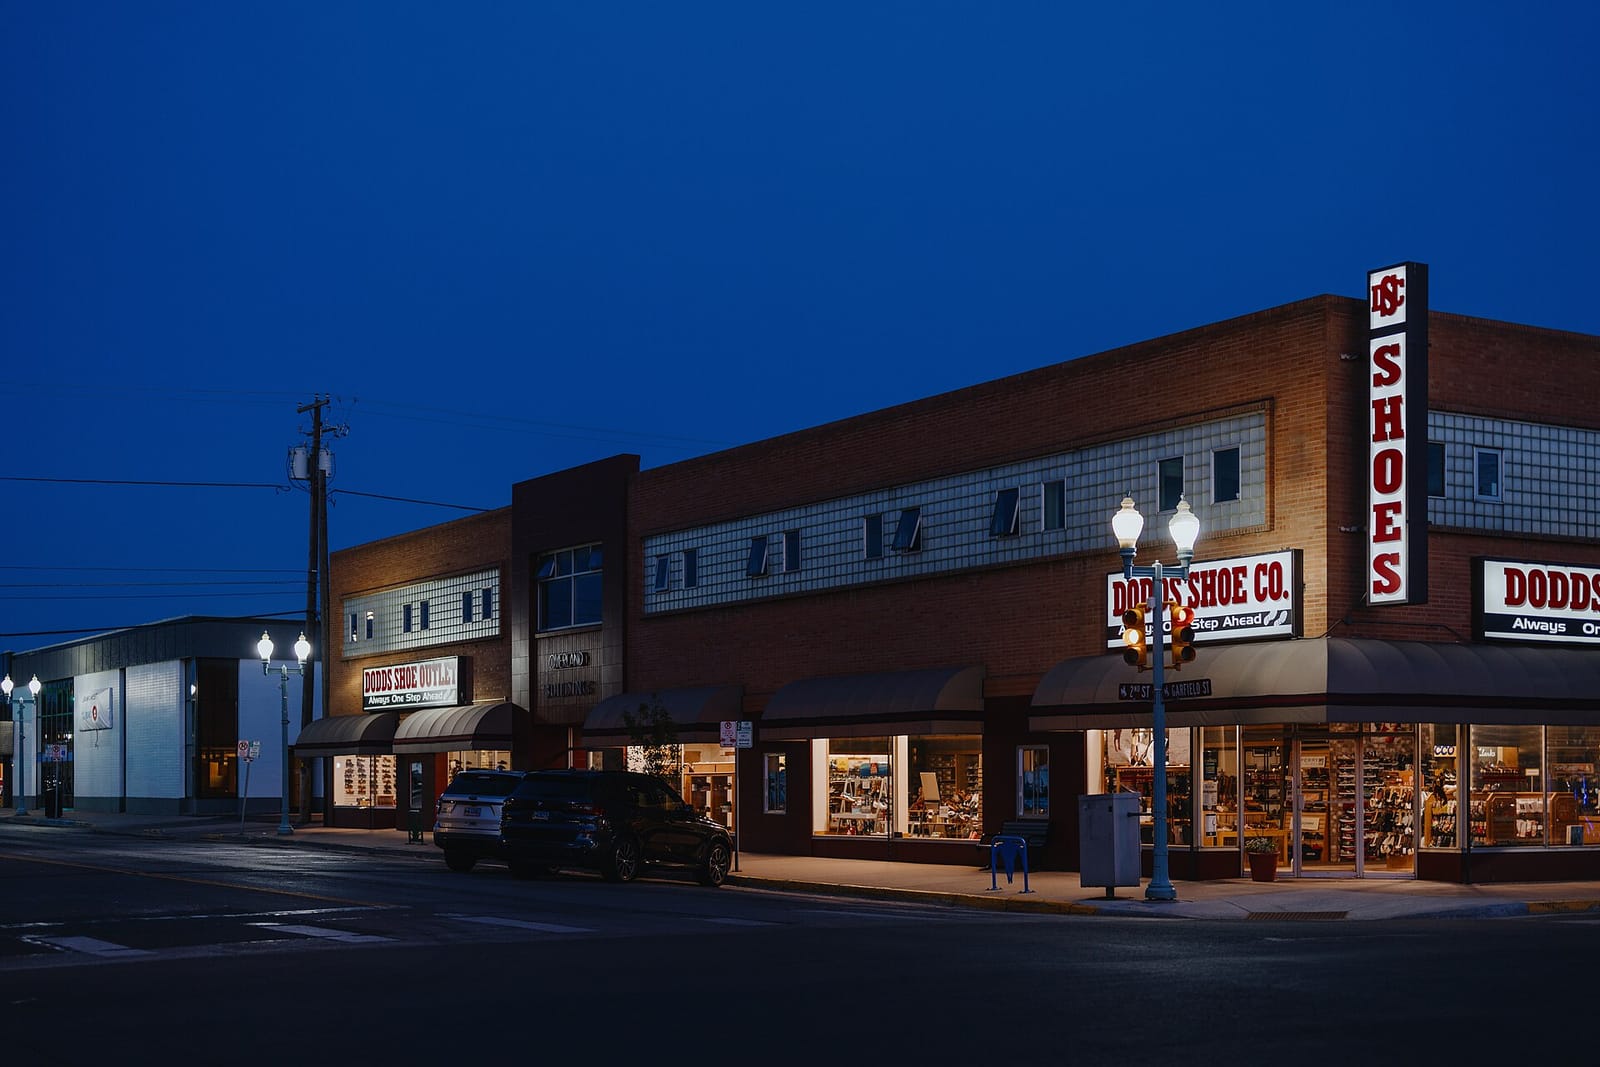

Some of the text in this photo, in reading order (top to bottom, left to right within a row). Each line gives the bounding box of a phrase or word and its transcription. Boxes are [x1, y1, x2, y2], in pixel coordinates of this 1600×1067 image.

[1372, 343, 1405, 594] SHOES
[1188, 566, 1248, 609] SHOE
[1254, 561, 1289, 602] CO.
[1190, 613, 1262, 631] Step Ahead
[1512, 618, 1566, 634] Always
[365, 662, 456, 693] DODDS SHOE OUTLET
[1171, 681, 1211, 697] GARFIELD ST
[368, 695, 390, 705] Always
[391, 694, 404, 703] One
[405, 693, 421, 702] Step
